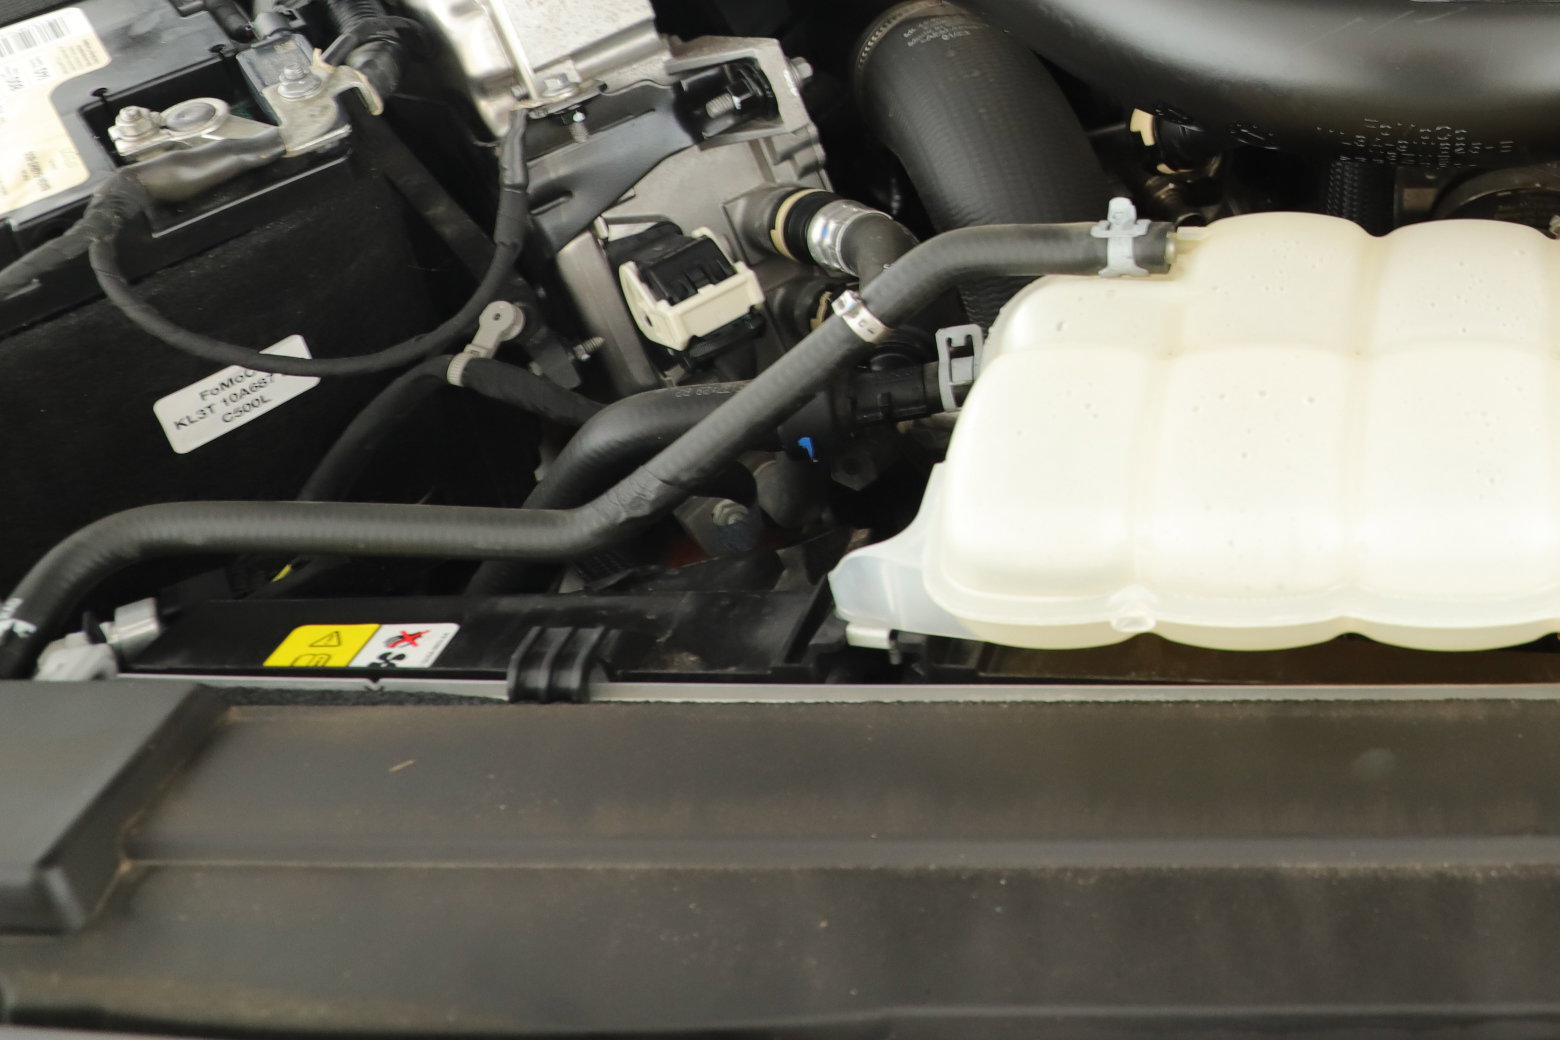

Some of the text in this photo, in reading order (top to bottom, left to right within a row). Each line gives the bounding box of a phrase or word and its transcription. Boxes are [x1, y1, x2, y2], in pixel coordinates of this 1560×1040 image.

[199, 368, 257, 402] FoMoC
[173, 403, 218, 431] KL3T
[221, 394, 272, 424] C500L
